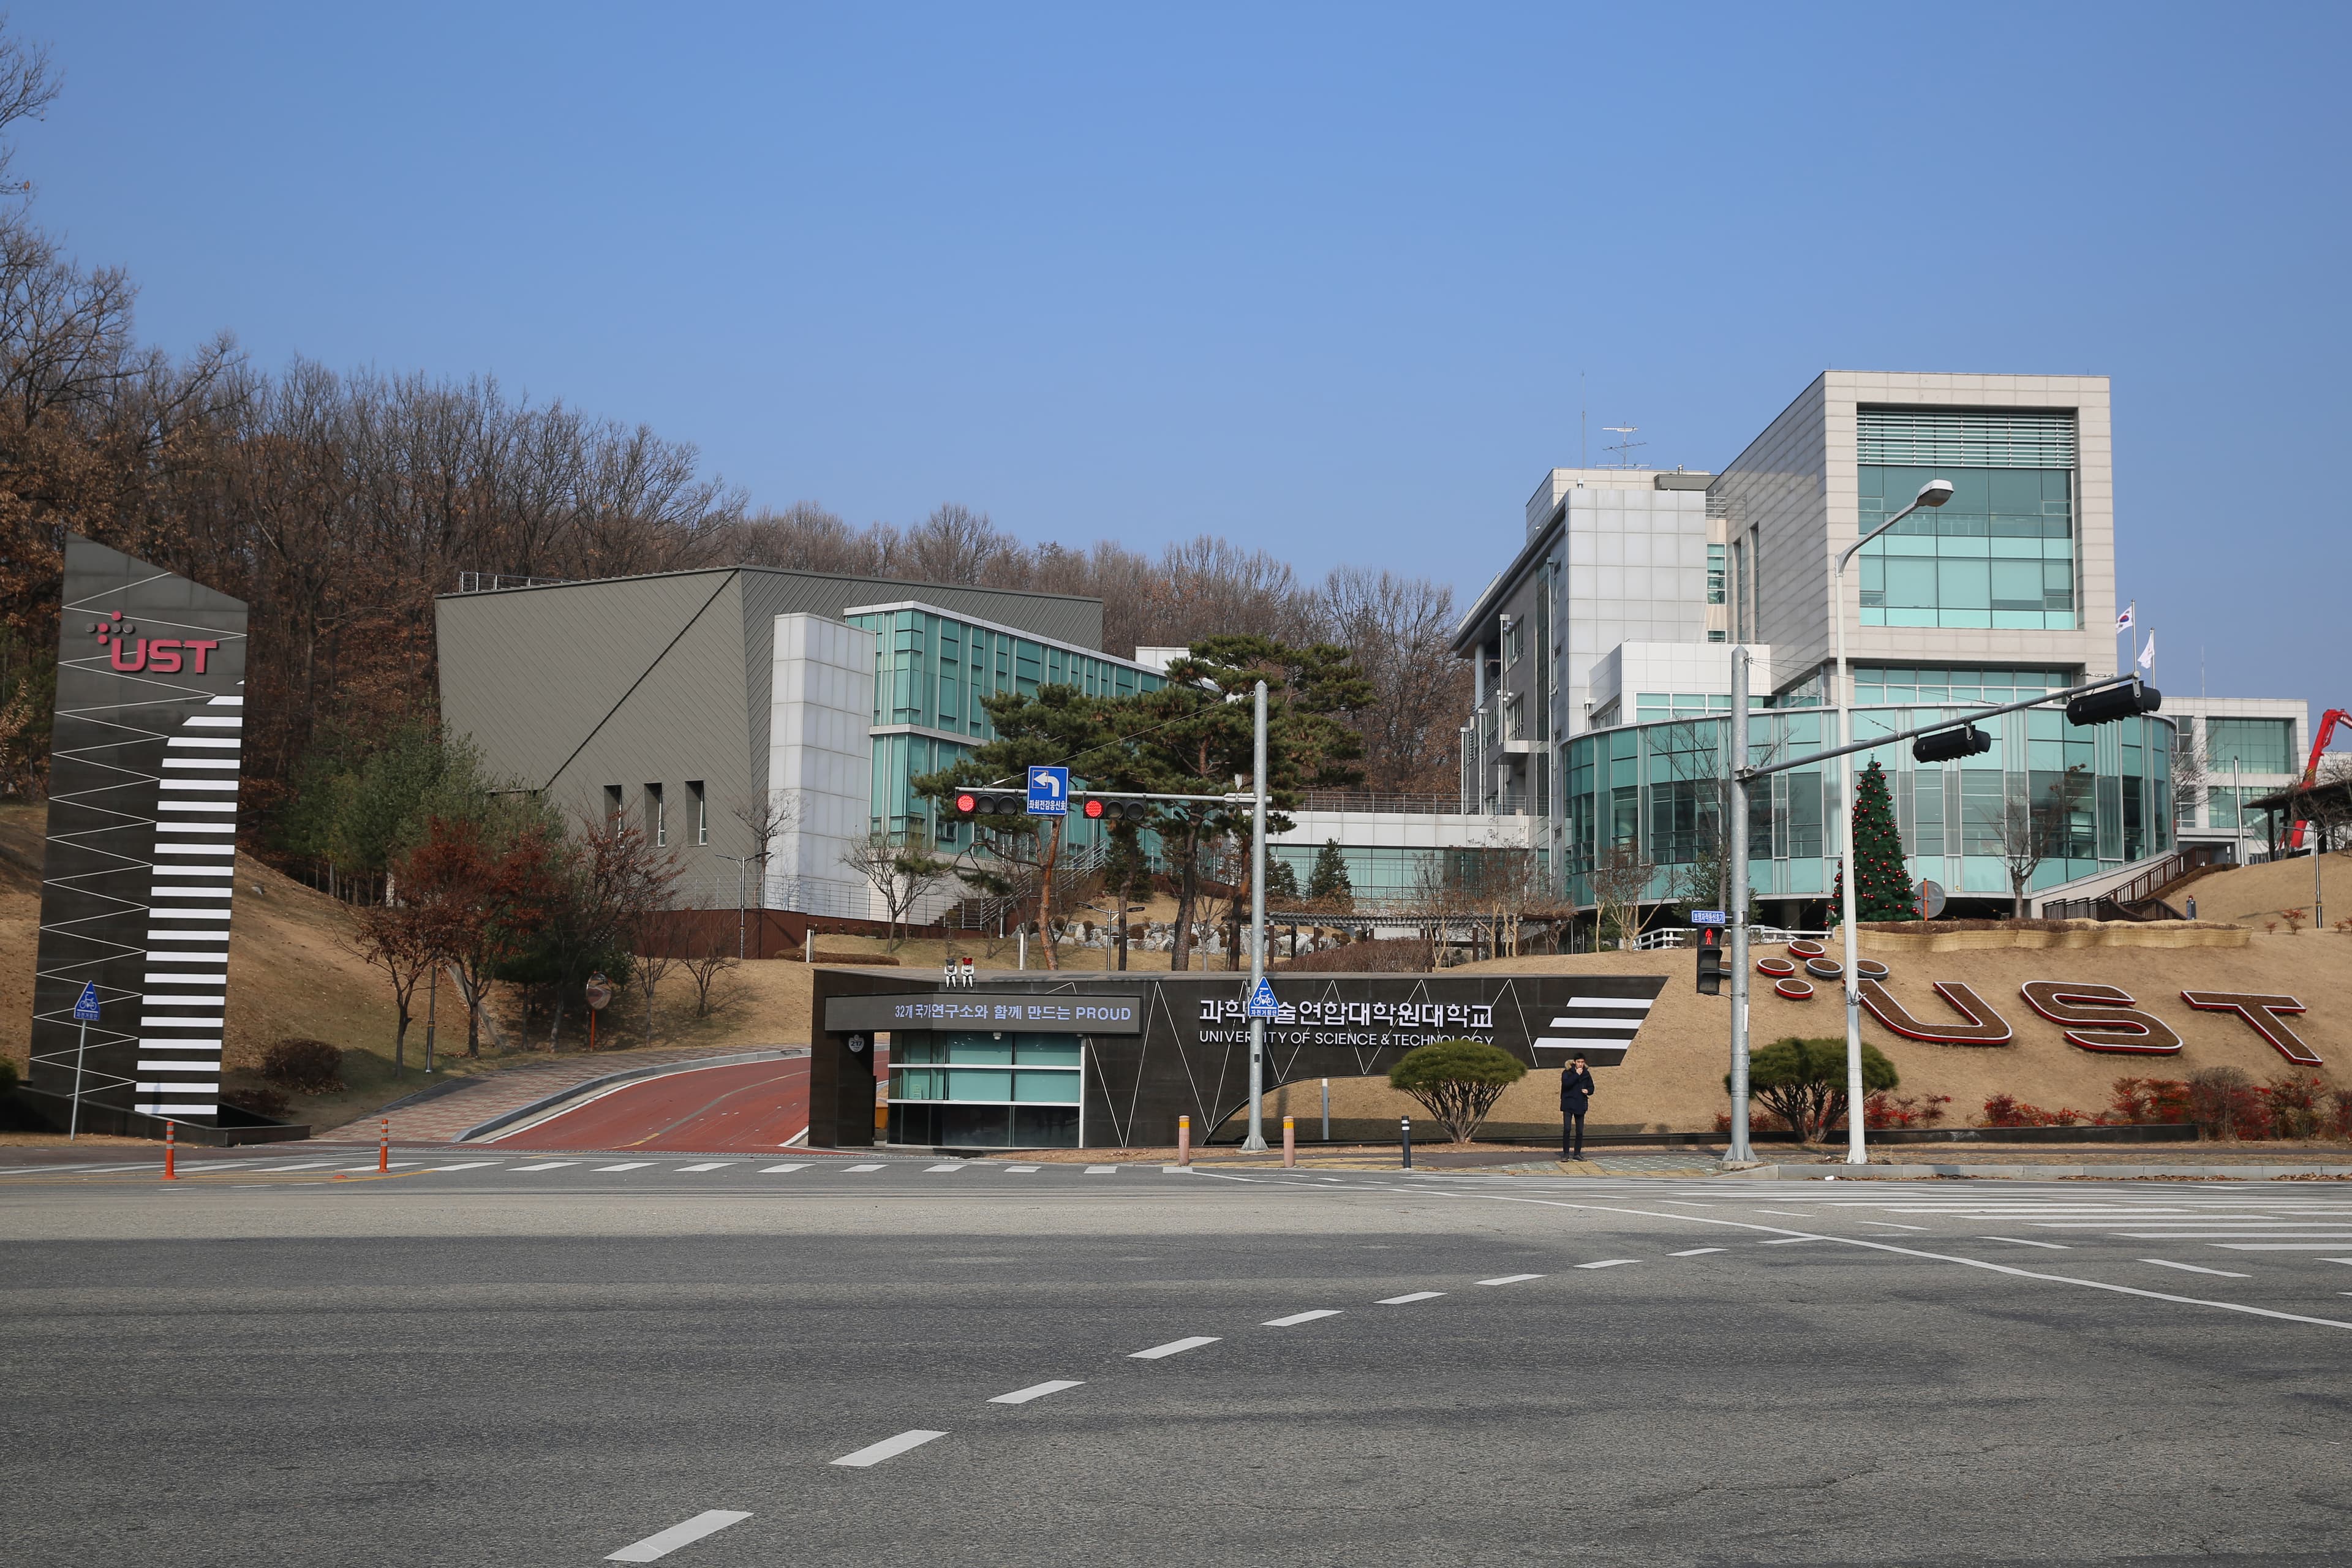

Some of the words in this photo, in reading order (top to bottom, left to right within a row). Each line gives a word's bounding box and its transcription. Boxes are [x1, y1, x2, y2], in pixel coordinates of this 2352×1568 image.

[111, 638, 218, 673] UST
[1029, 799, 1066, 811] 좌회전감응신호
[895, 1005, 913, 1019] 32개
[915, 1004, 988, 1019] 국가연구소와
[994, 1005, 1022, 1020] 함께
[1028, 1006, 1071, 1020] 만드는
[1076, 1006, 1131, 1020] PROUD
[1199, 999, 1493, 1028] 과학술연합대학원대학교
[1842, 978, 2323, 1066] UST
[1199, 1030, 1287, 1044] UNIVERITY
[1291, 1032, 1311, 1044] OF
[1315, 1033, 1378, 1046] SCIENCE
[1381, 1033, 1390, 1046] &
